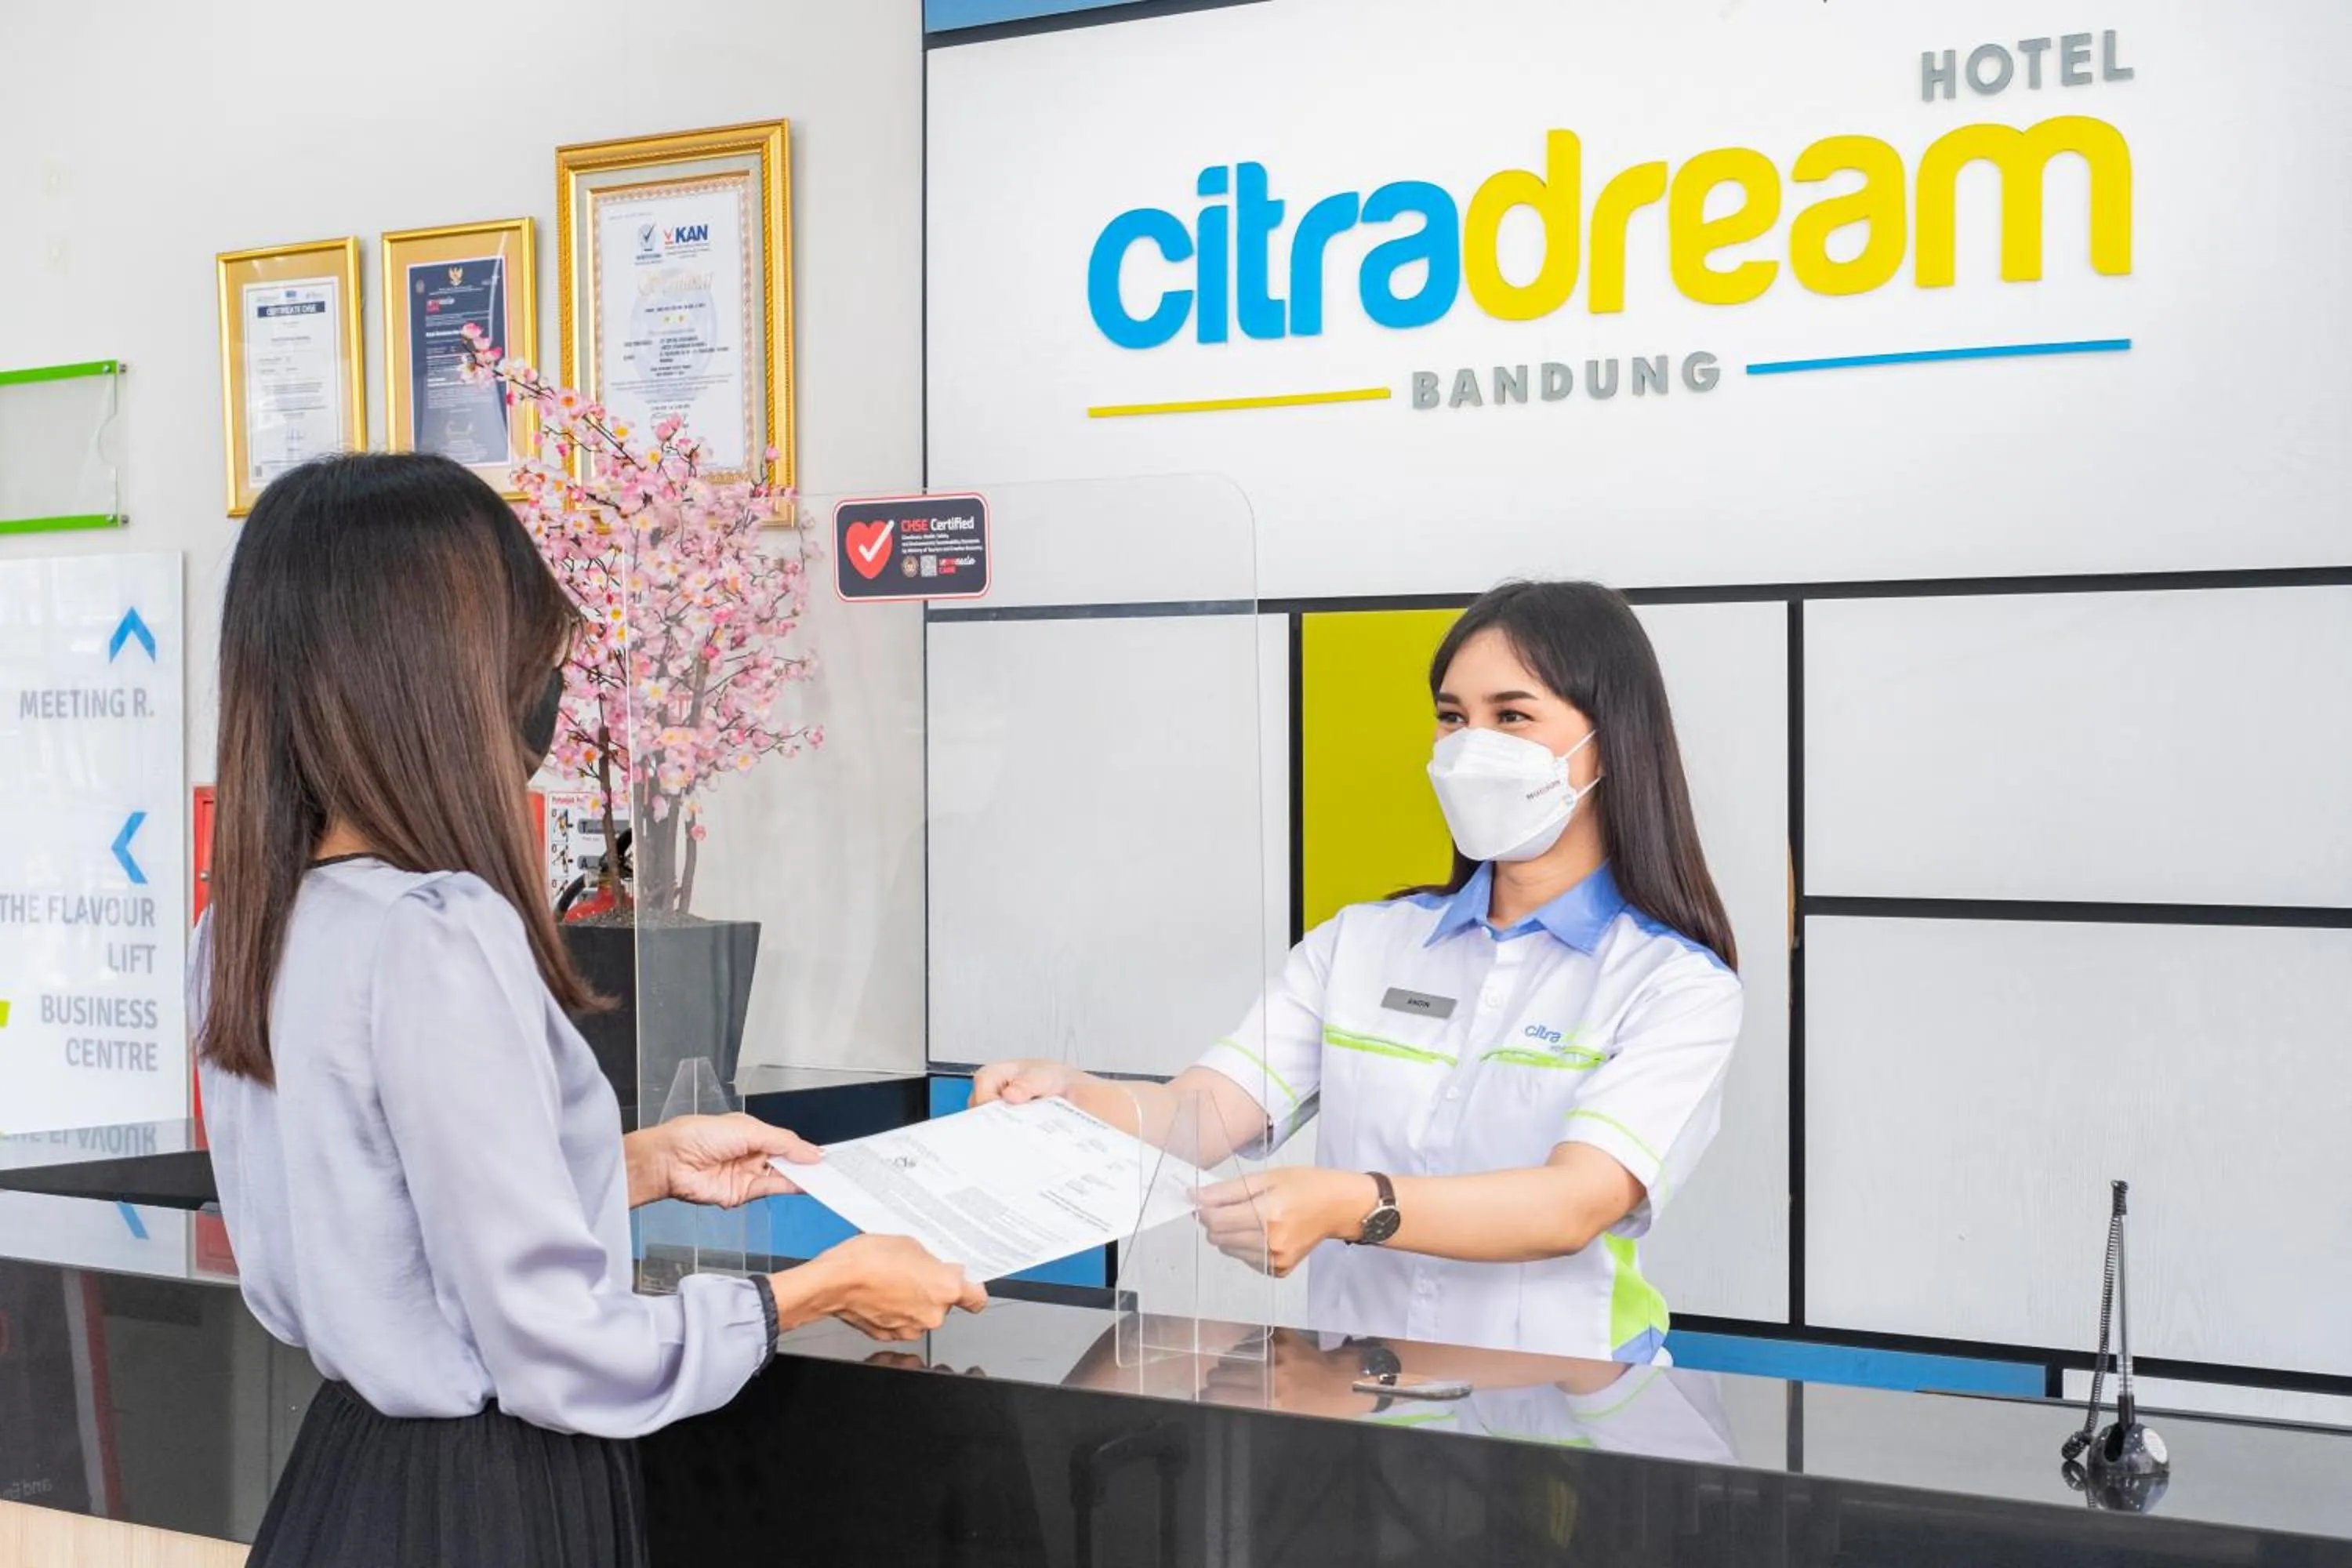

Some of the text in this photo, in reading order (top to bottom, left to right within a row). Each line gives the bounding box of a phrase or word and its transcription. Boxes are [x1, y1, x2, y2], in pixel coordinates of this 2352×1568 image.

[1922, 30, 2134, 102] HOTEL
[675, 223, 709, 244] KAN
[1087, 115, 2133, 350] citradream
[1412, 350, 1721, 411] BANDUNG
[901, 516, 975, 532] CHSE Certified
[20, 687, 155, 719] MEETING R.
[0, 894, 156, 927] THE FLAVOUR
[107, 942, 157, 975] LIFT
[41, 995, 158, 1030] BUSINESS
[1525, 1024, 1562, 1044] citra
[66, 1038, 158, 1073] CENTRE
